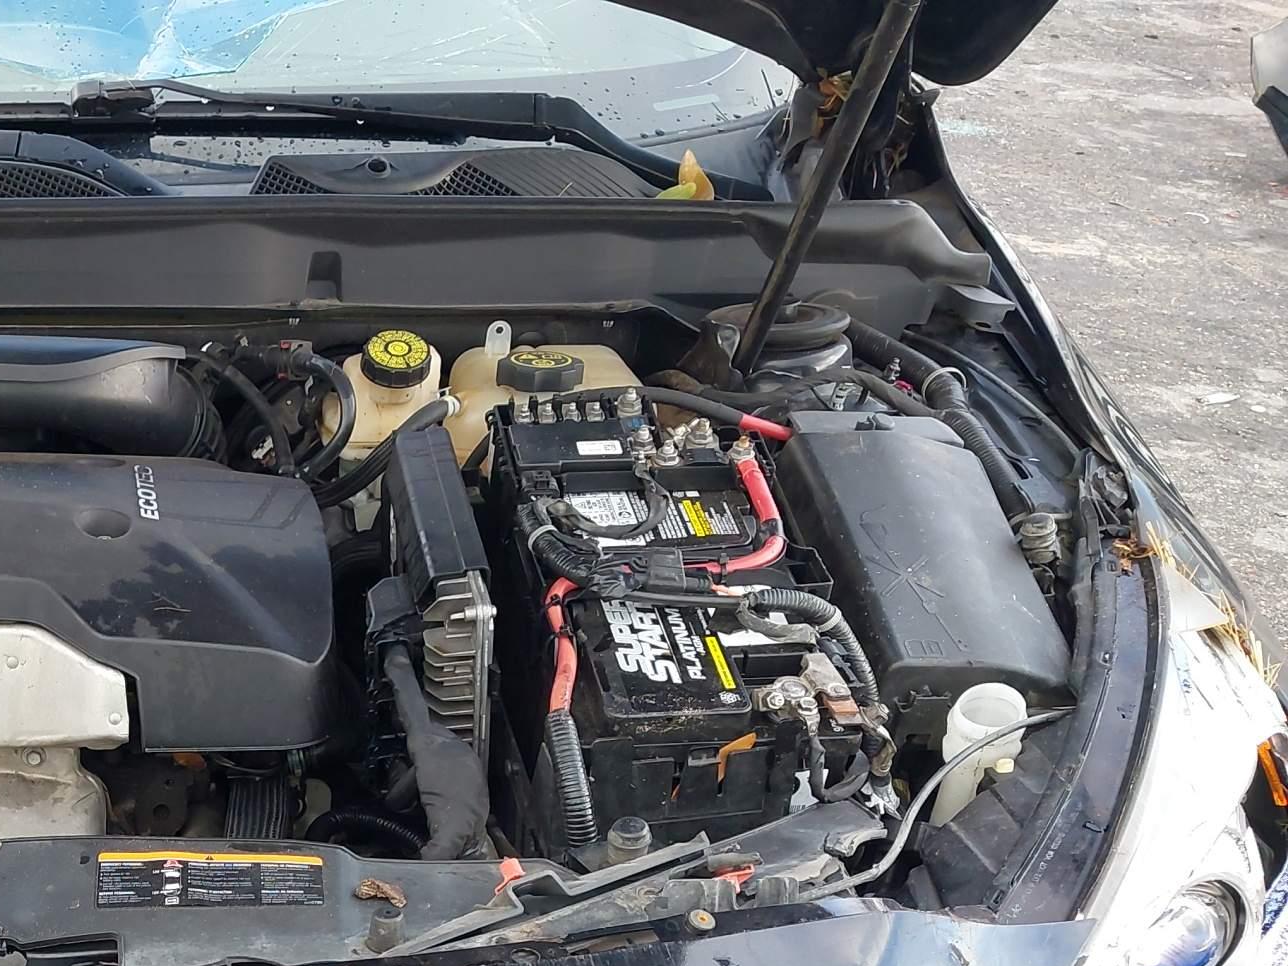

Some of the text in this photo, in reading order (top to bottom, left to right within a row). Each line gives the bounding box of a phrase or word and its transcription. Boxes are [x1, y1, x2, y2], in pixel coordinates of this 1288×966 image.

[133, 464, 160, 521] ECOTEC
[624, 600, 683, 684] START
[663, 607, 707, 680] PLATINUM
